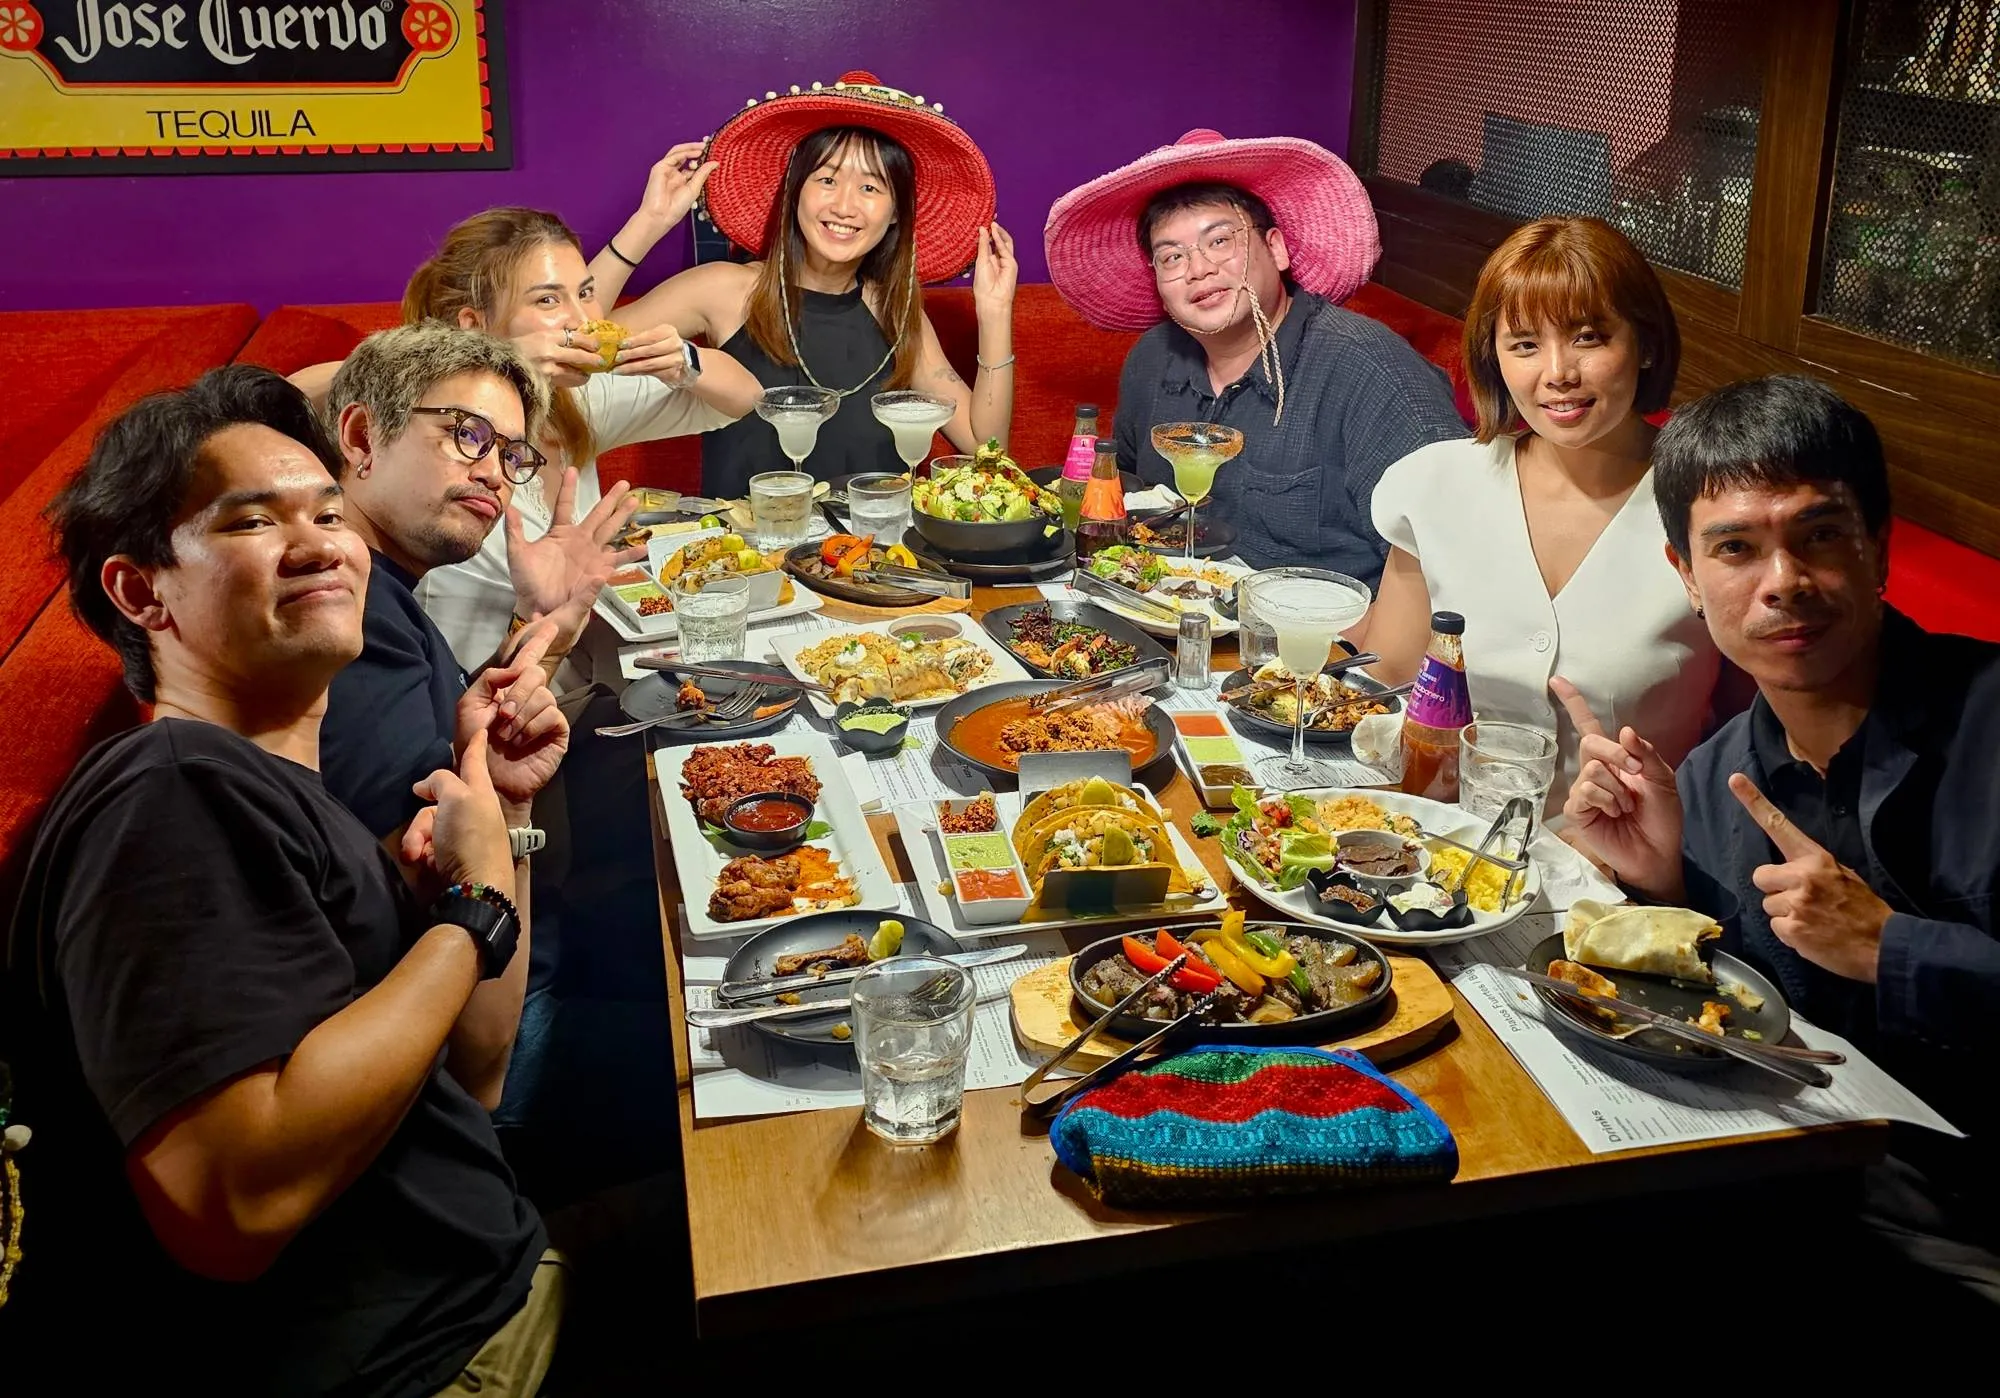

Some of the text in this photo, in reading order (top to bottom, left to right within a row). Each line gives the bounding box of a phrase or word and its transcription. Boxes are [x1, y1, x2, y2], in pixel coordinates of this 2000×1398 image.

[146, 109, 316, 139] TEQUILA
[1465, 968, 1479, 982] Big
[1500, 1009, 1521, 1032] Platos
[1591, 1109, 1622, 1143] Drinks
